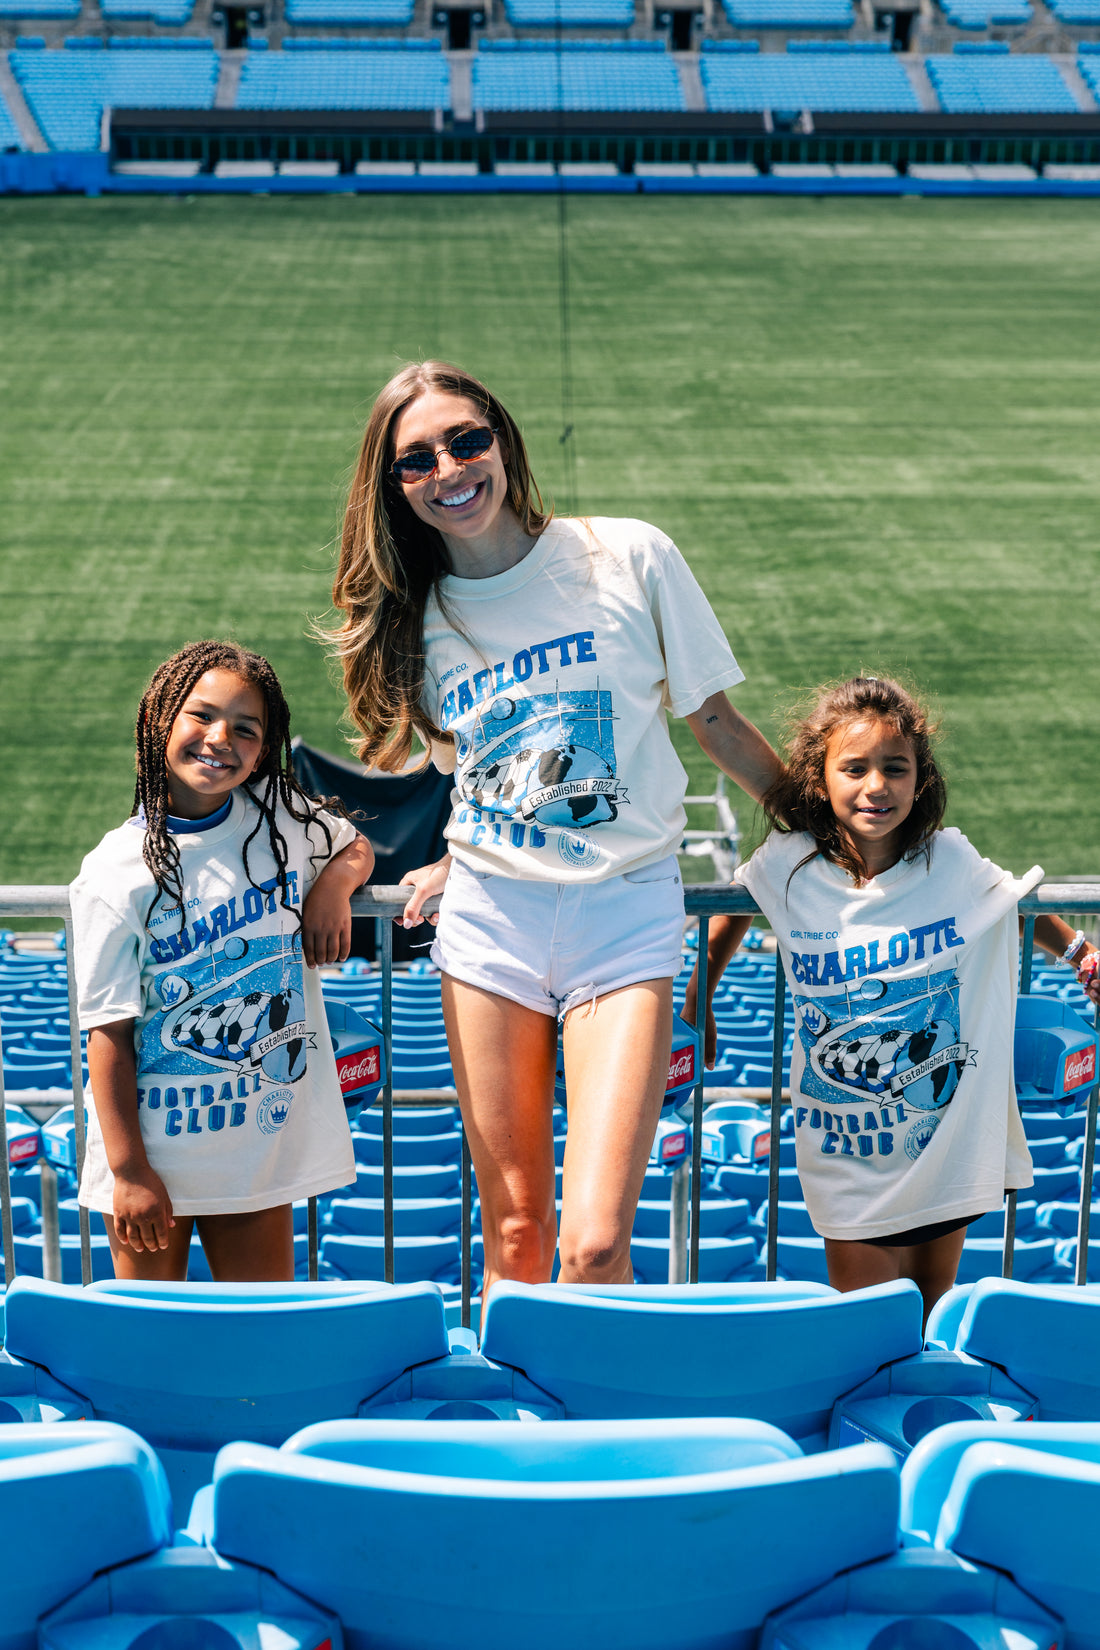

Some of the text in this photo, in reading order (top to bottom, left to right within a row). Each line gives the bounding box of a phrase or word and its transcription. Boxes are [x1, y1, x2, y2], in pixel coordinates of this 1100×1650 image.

[455, 663, 469, 673] CO.
[529, 780, 612, 808] Established 2022
[469, 822, 546, 848] CLUB
[187, 897, 202, 909] CO.
[825, 930, 841, 940] CO.
[791, 916, 965, 986] CHARLOTTE
[339, 1054, 378, 1085] Coca-Cola
[1066, 1053, 1094, 1082] Coca-Cola
[137, 1073, 262, 1110] FOOTBALL
[165, 1102, 247, 1136] CLUB
[796, 1103, 908, 1134] FOOTBALL
[821, 1132, 893, 1156] CLUB
